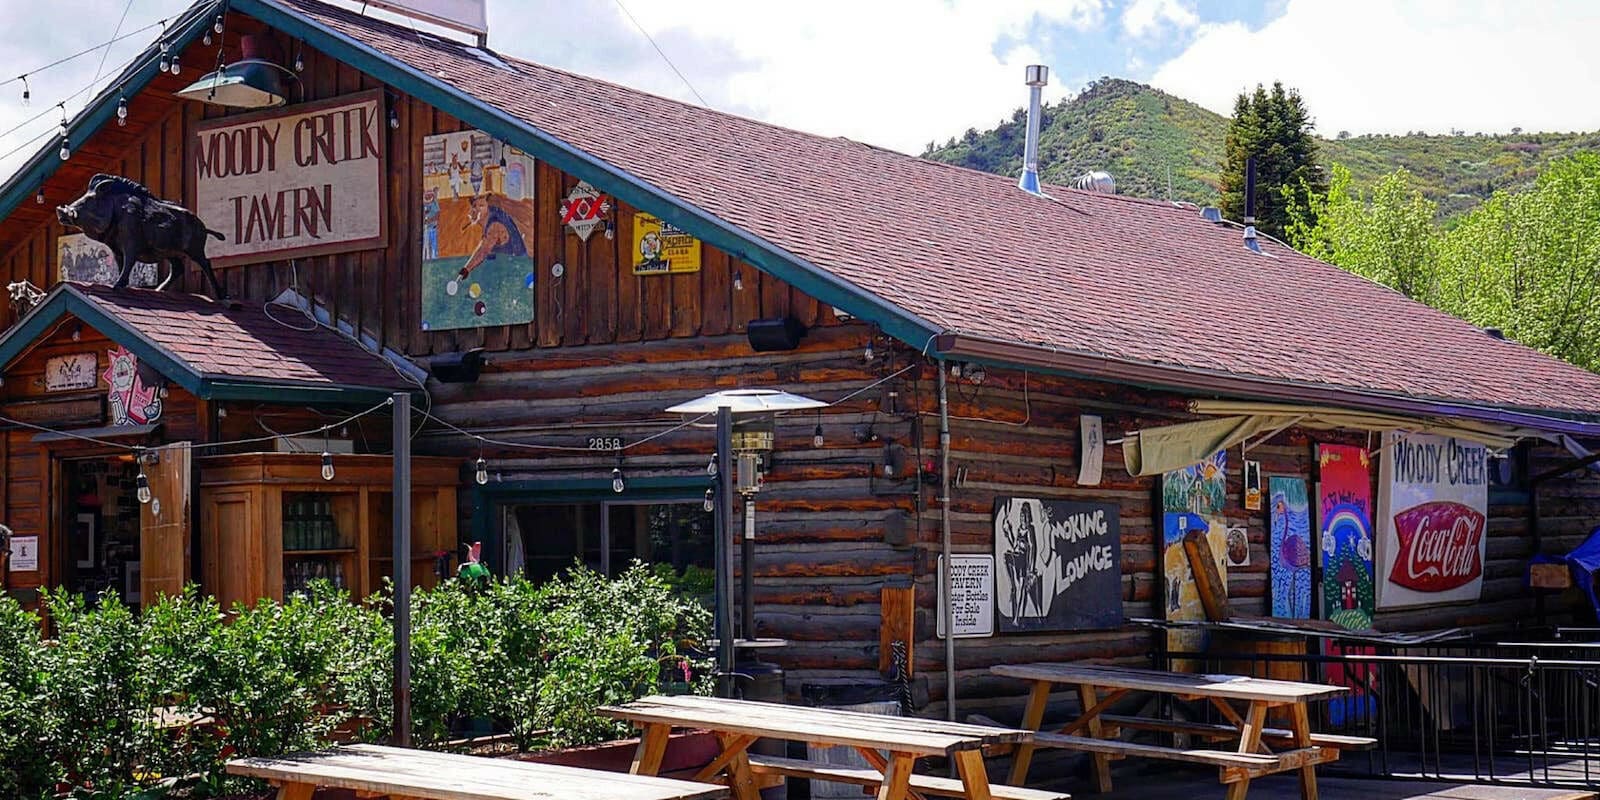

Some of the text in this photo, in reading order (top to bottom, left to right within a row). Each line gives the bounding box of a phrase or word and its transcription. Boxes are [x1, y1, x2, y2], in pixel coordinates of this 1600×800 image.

[195, 105, 381, 180] WOODY CREEK
[229, 184, 333, 245] TAVERN
[588, 437, 621, 450] 2858
[1393, 435, 1486, 485] WOODY CREEK
[1408, 516, 1477, 579] Coca-Cola
[968, 565, 989, 576] CREEK
[1055, 545, 1112, 595] LOUNGE
[964, 603, 980, 614] Sale
[966, 590, 989, 602] Bottles
[955, 615, 977, 626] Inside
